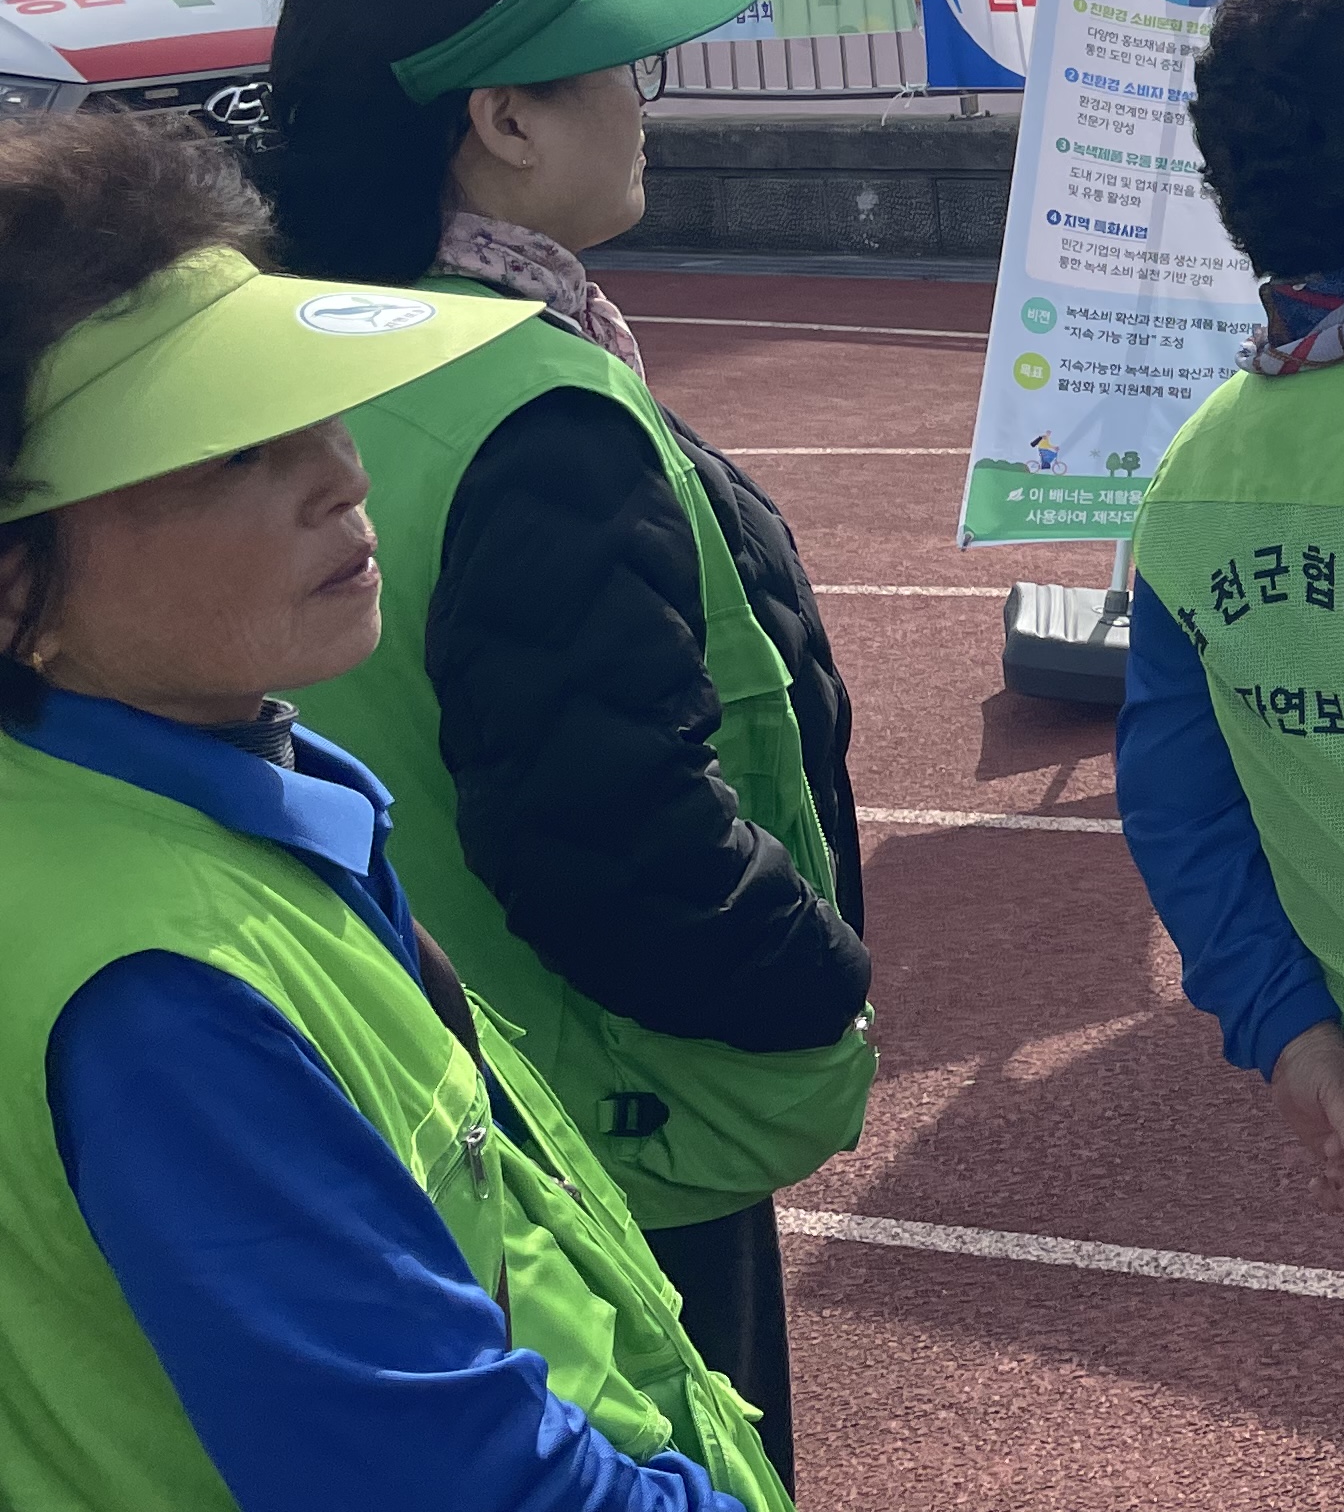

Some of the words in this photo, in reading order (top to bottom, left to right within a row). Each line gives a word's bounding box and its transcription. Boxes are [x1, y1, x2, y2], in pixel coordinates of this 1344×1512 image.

[1123, 82, 1163, 99] 소비자
[1063, 213, 1090, 231] 지역
[1061, 238, 1083, 254] 민간
[1086, 243, 1121, 259] 기업의
[1173, 254, 1198, 268] 생산
[1200, 257, 1223, 271] 지원
[1110, 264, 1134, 279] 소비
[1163, 270, 1187, 285] 기반
[1190, 273, 1214, 288] 강화
[1066, 305, 1112, 323] 녹색소비
[1153, 315, 1188, 330] 친환경
[1160, 336, 1185, 350] 조성
[1059, 358, 1123, 376] 지속가능한
[1124, 364, 1174, 380] 녹색소비
[1029, 488, 1044, 503] 이
[1049, 488, 1094, 505] 배너는
[1026, 509, 1087, 525] 사용하여
